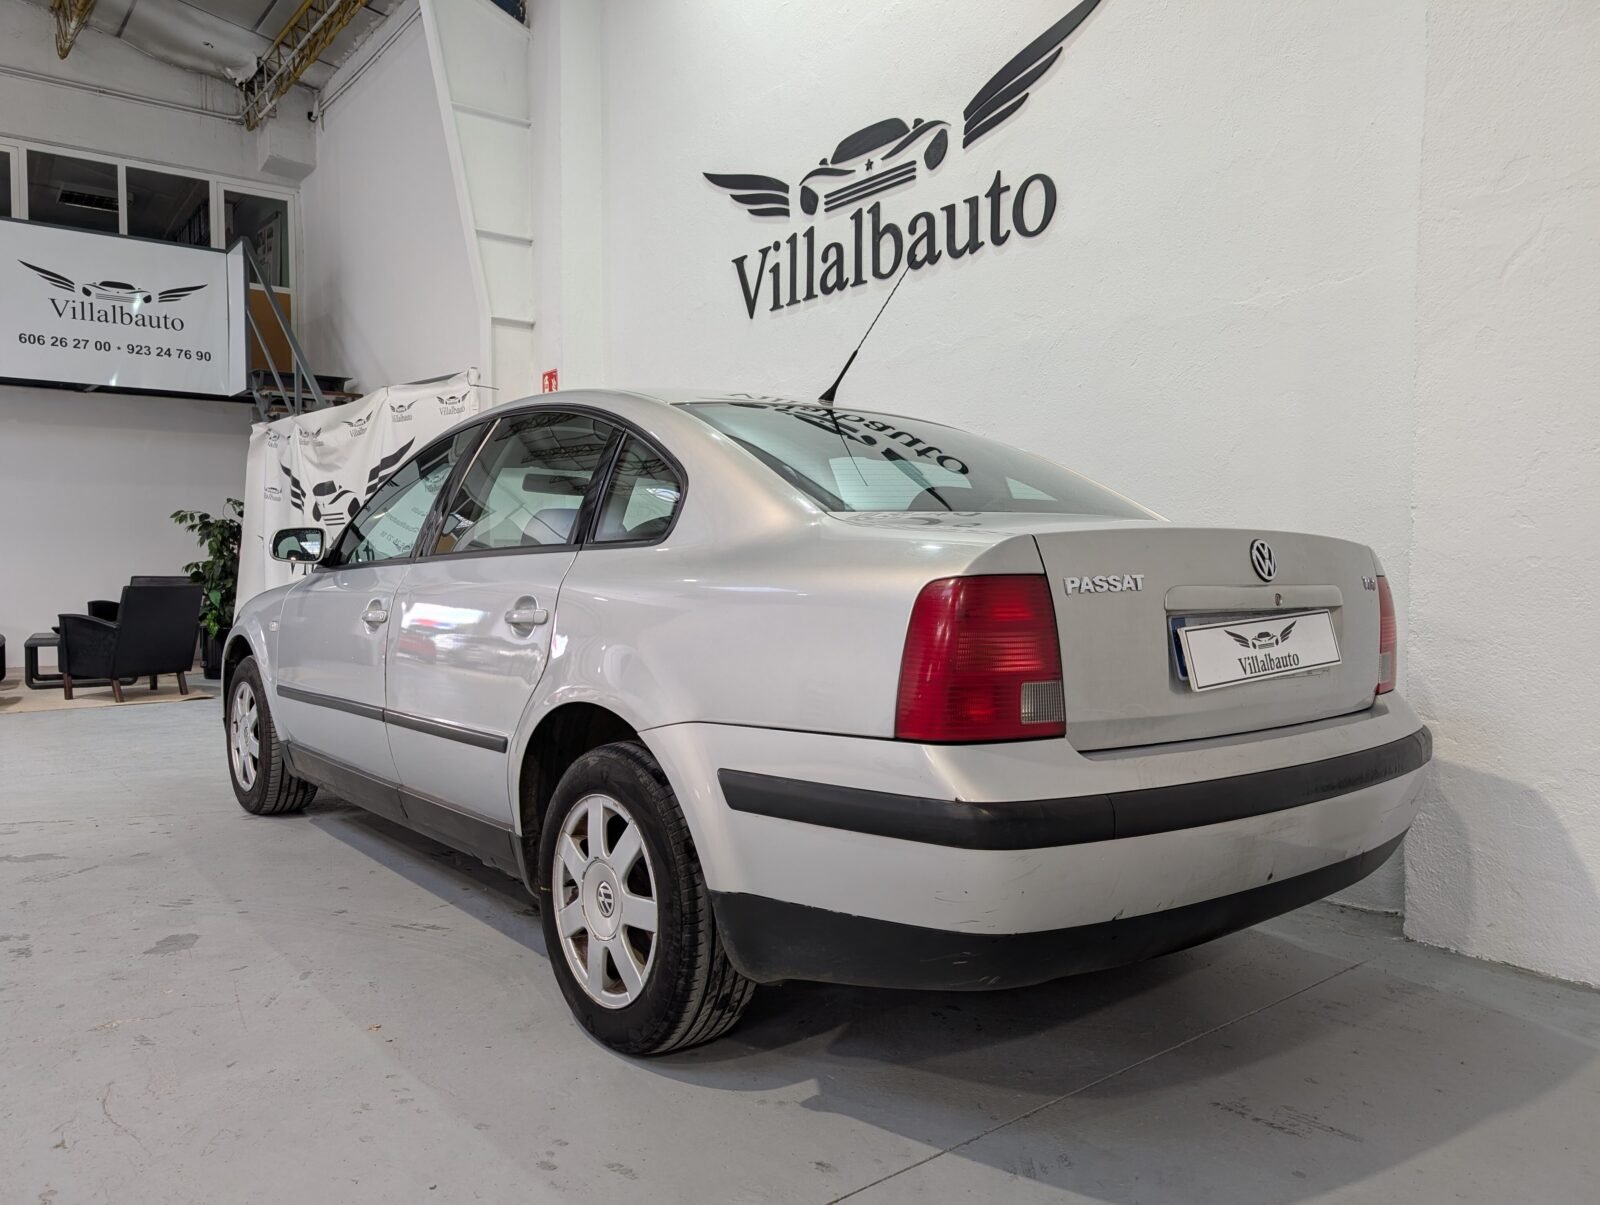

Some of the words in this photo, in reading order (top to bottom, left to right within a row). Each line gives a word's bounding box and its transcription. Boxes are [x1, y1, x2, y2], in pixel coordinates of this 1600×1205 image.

[731, 170, 1058, 320] Villalbauto
[48, 297, 184, 331] Villalbauto
[18, 332, 46, 346] 606
[50, 335, 68, 348] 26
[72, 338, 89, 350] 27
[94, 340, 111, 352] 00
[126, 343, 152, 356] 923
[155, 346, 172, 358] 24
[176, 348, 192, 360] 76
[195, 350, 212, 362] 90
[1063, 573, 1145, 596] PASSAT
[1238, 651, 1300, 676] Villalbauto
